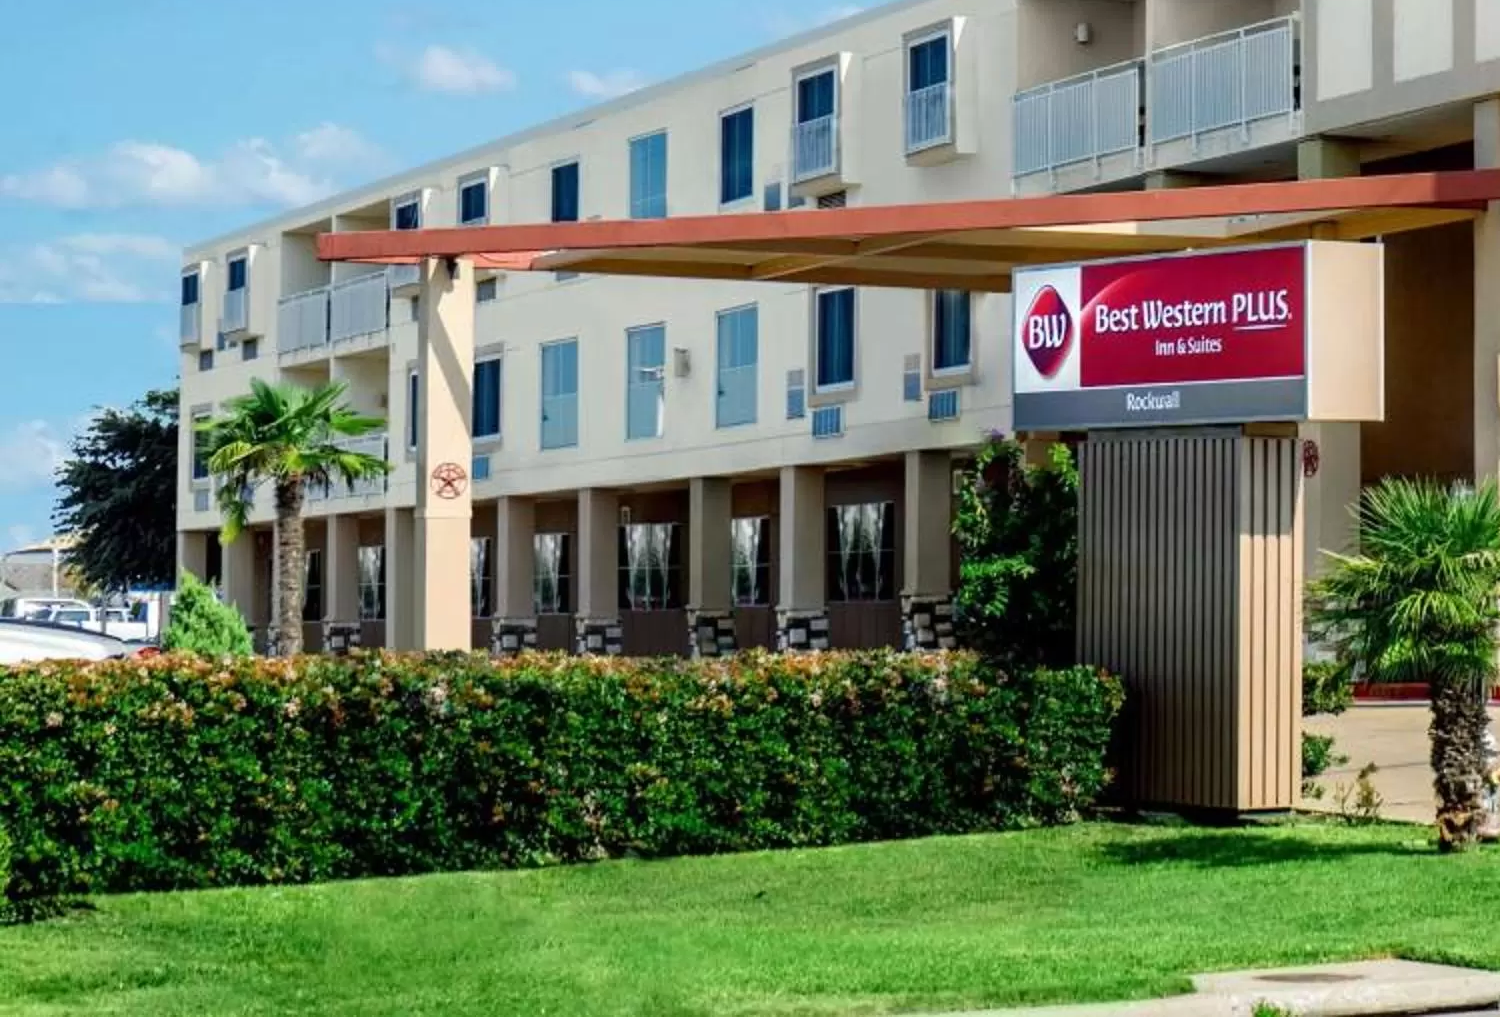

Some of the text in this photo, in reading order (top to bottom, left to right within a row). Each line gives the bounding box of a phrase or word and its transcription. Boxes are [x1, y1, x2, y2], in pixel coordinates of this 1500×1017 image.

[1028, 311, 1067, 350] BW
[1095, 303, 1139, 334] Best
[1142, 298, 1227, 330] Western
[1155, 336, 1223, 356] Inn & Suites
[1126, 389, 1181, 412] Rockwall
